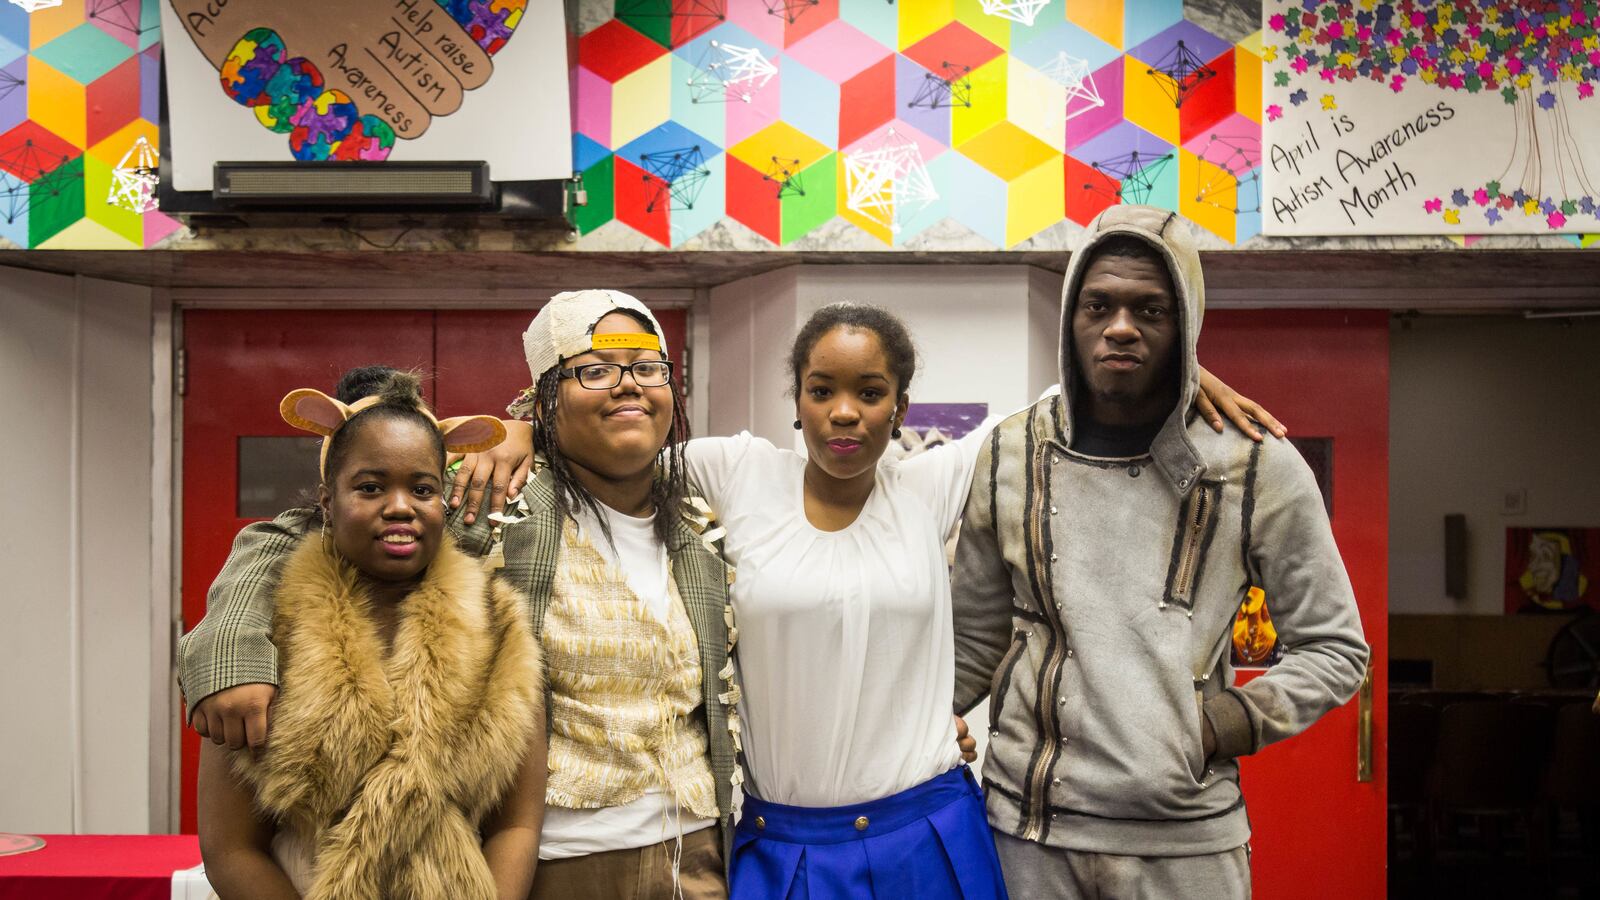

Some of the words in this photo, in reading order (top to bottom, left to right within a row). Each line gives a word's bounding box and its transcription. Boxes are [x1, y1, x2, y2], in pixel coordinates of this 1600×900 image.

[395, 0, 434, 36] Help
[434, 34, 475, 75] raise
[328, 43, 413, 132] Awareness
[1270, 121, 1320, 175] April
[1331, 114, 1355, 137] is
[1335, 101, 1455, 184] Awareness
[1339, 161, 1417, 226] Month
